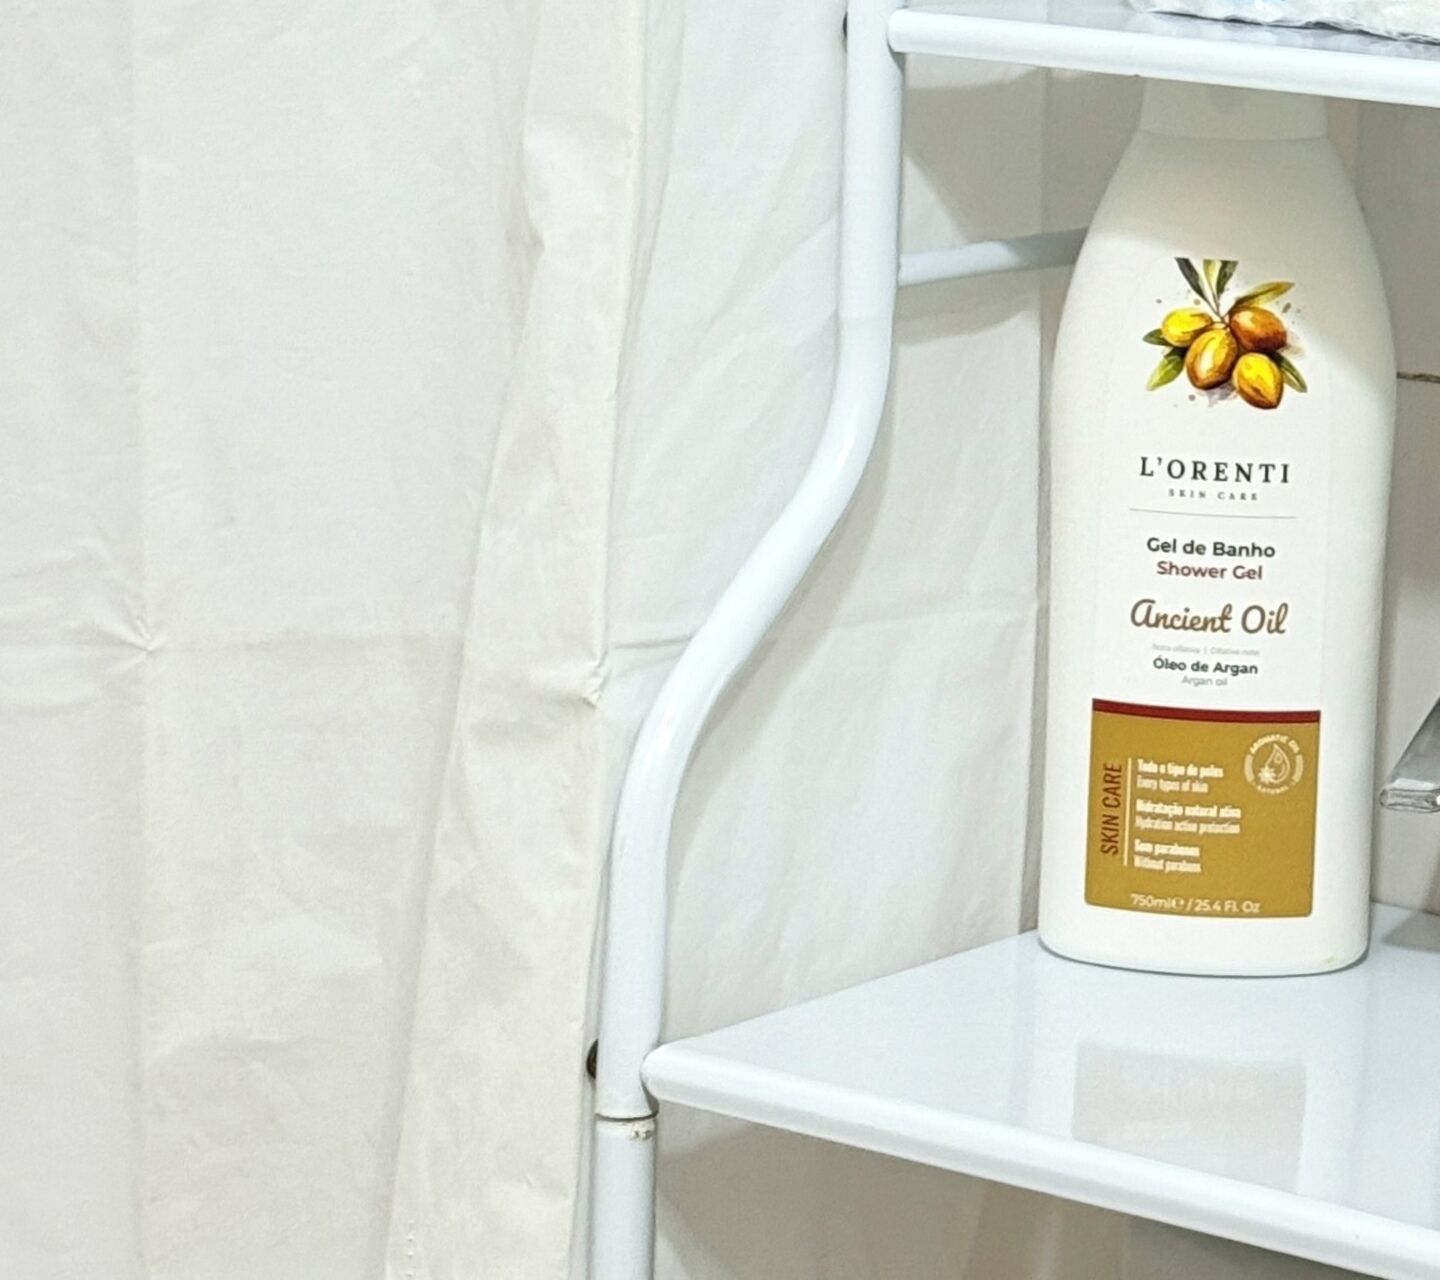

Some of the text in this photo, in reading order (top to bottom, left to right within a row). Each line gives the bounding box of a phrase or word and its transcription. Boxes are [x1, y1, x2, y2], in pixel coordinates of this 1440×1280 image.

[1140, 456, 1290, 484] L'ORENTI
[1168, 488, 1258, 501] SKIN CARE
[1147, 537, 1275, 558] Gel de Banho
[1156, 560, 1263, 581] Shower Gel
[1130, 598, 1289, 634] Ancient Oil
[1153, 655, 1258, 676] Óleo de Argan
[1181, 675, 1228, 688] Argan oil
[1100, 762, 1122, 856] SKIN CARE
[1194, 899, 1221, 912] 25.4
[1241, 901, 1260, 912] Oz
